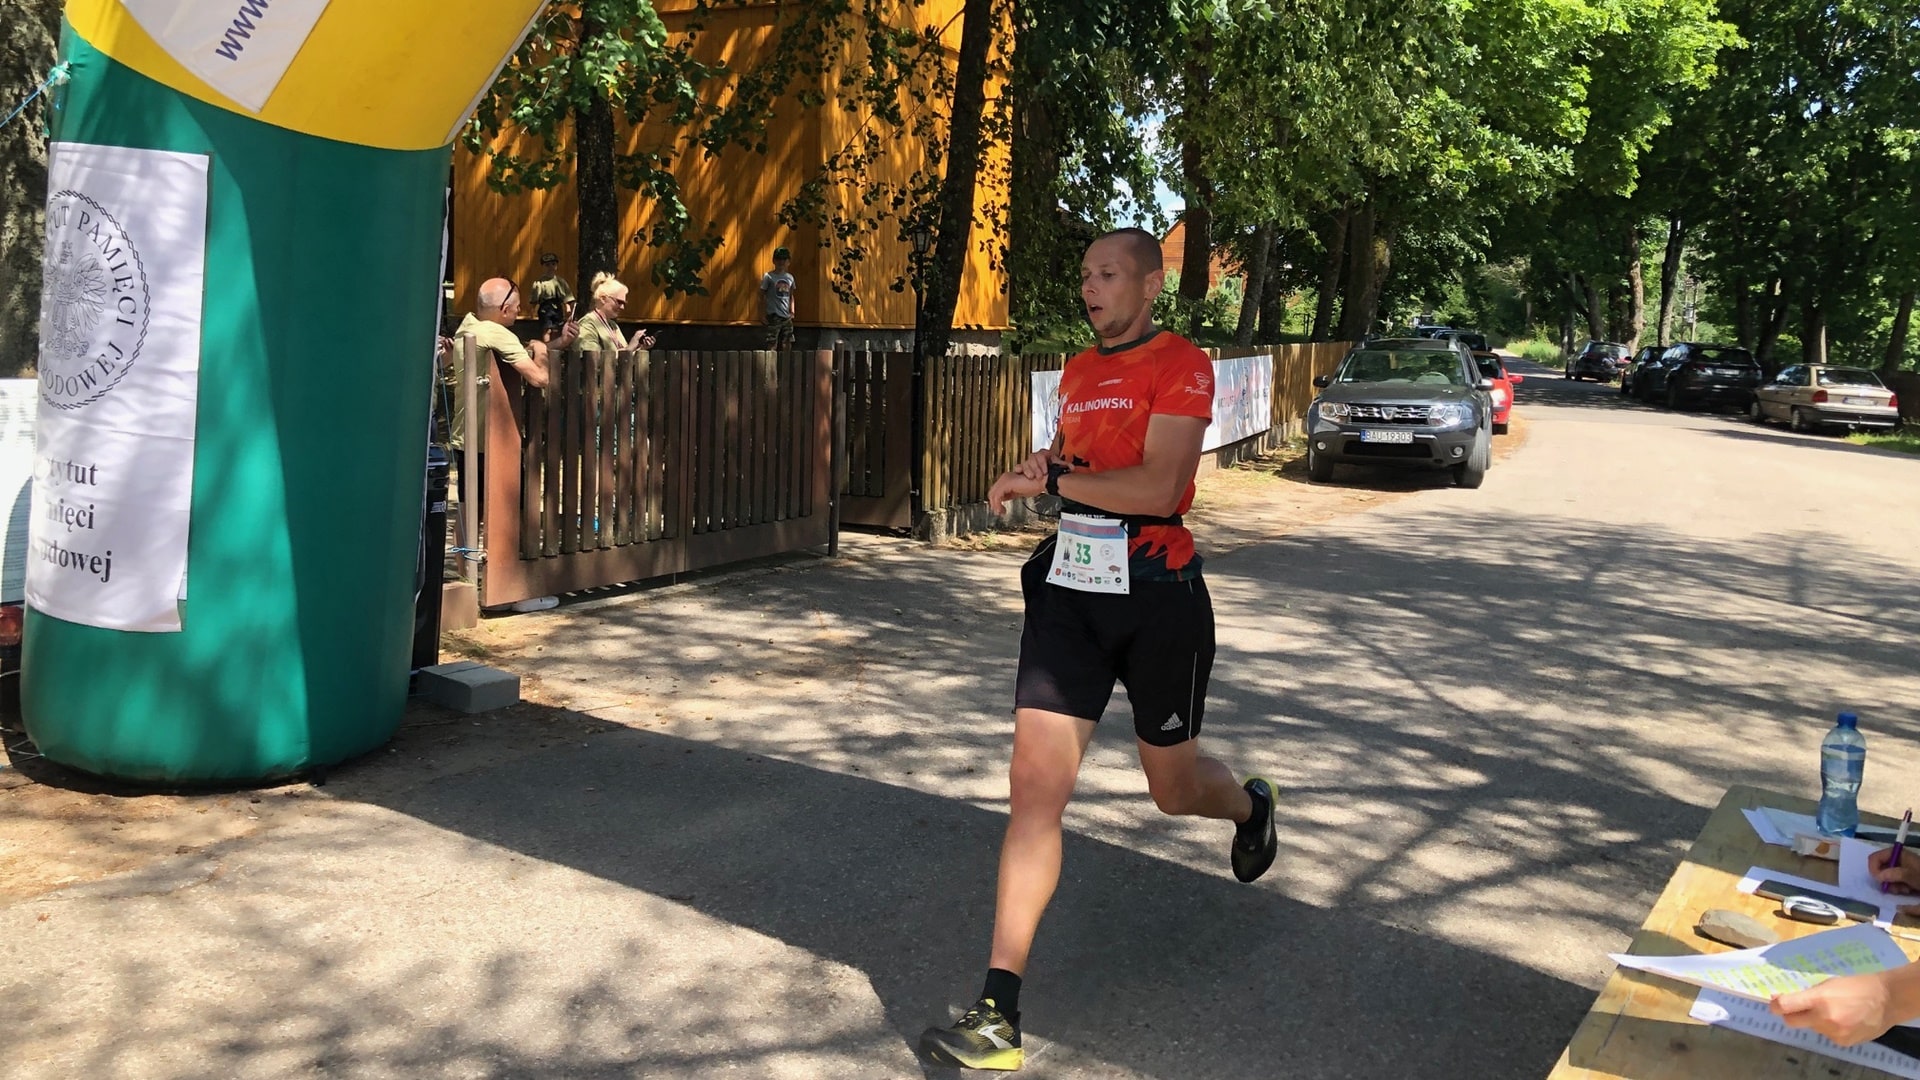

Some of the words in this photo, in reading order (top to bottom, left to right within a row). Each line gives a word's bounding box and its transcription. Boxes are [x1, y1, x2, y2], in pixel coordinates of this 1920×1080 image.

[77, 210, 138, 328] PAMIĘCI
[1066, 397, 1133, 414] KALINOWSKI
[1074, 542, 1092, 565] 33
